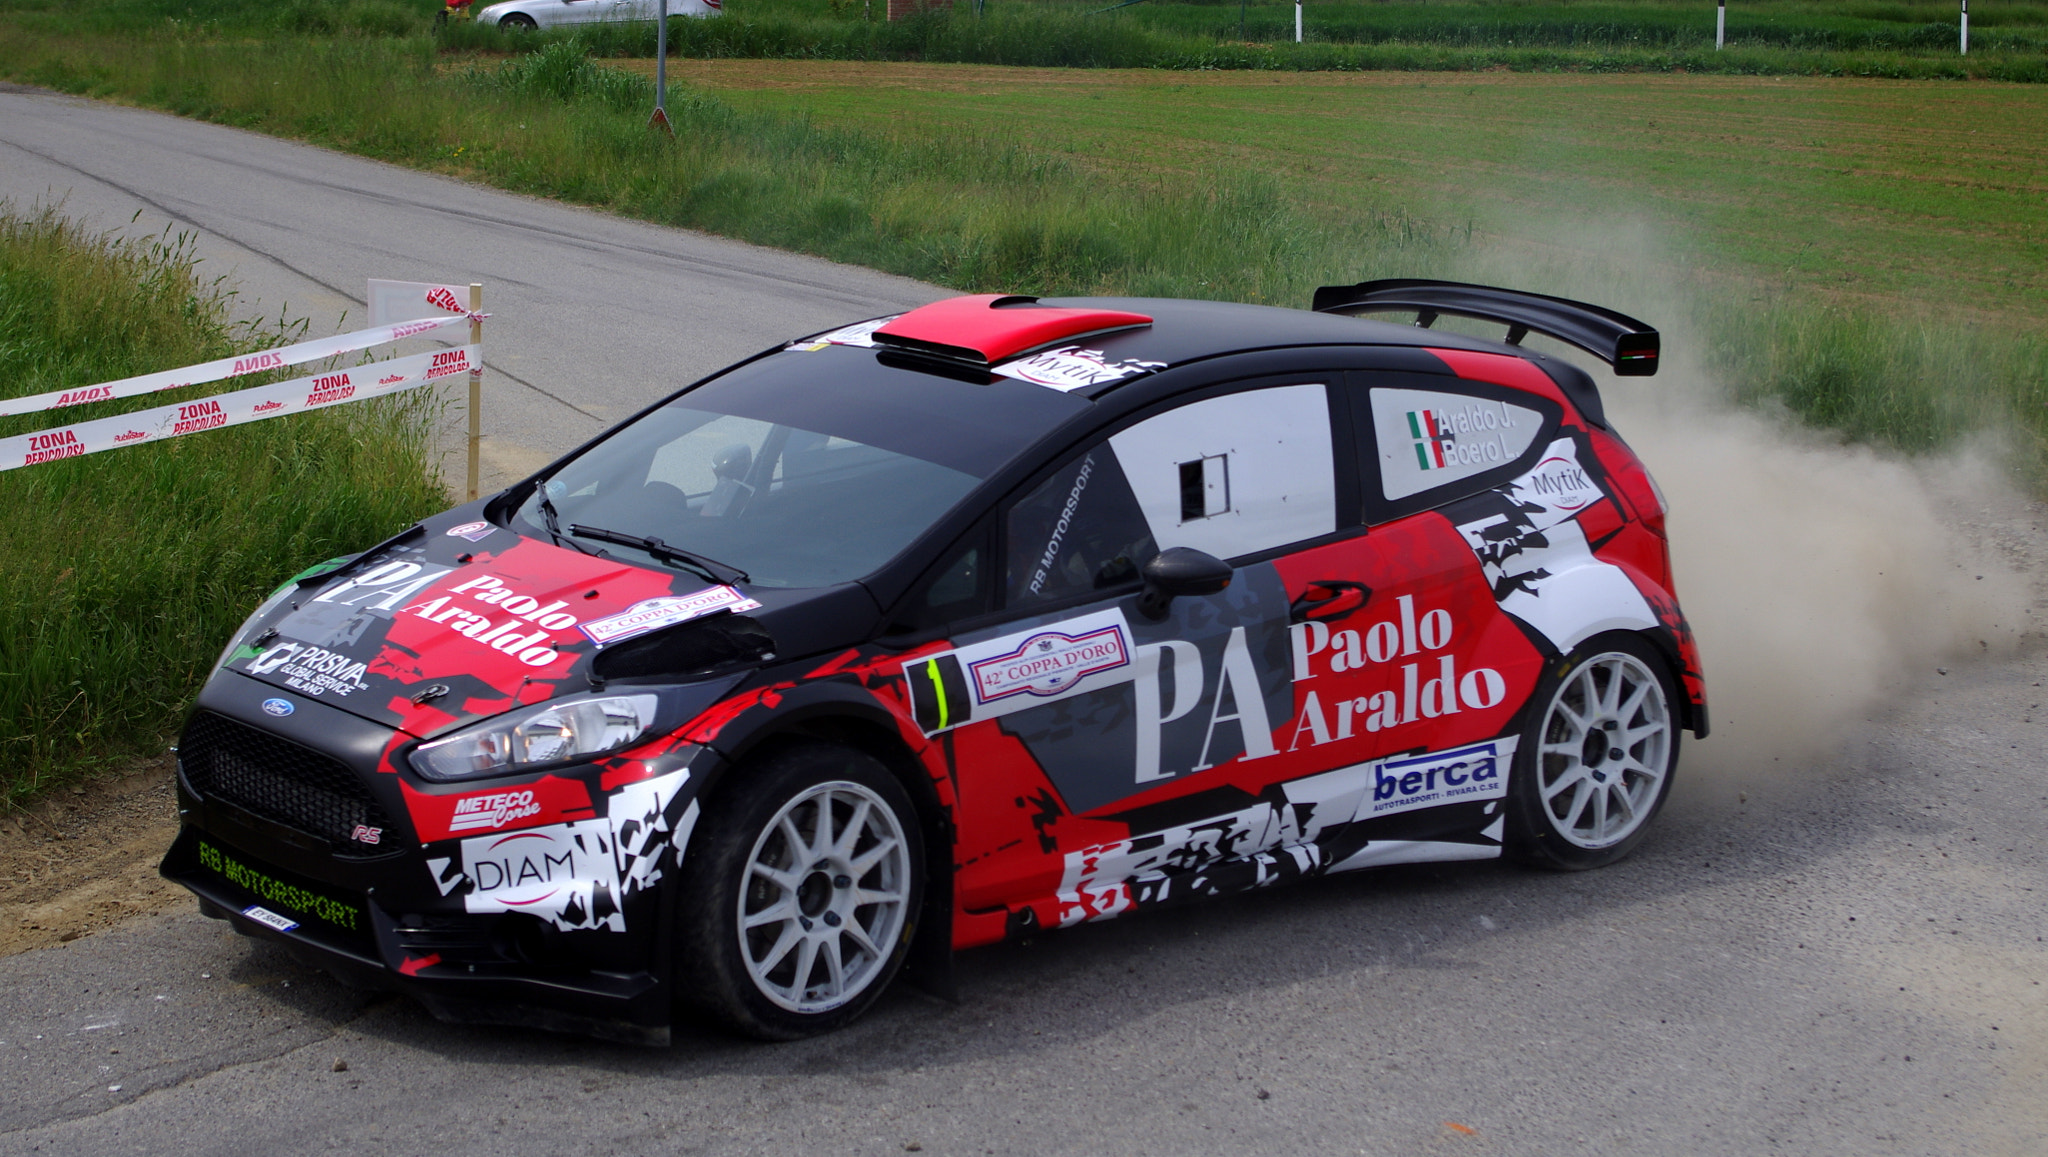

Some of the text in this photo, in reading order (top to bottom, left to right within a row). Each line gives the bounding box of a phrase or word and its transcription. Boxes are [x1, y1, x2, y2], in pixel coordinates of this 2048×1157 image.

[423, 361, 470, 380] PERICOLOSA
[432, 350, 465, 367] ZONA
[305, 386, 356, 407] PERICOLOSA
[312, 373, 350, 392] ZONA
[172, 413, 227, 436] PERICOLOSA
[178, 400, 222, 421] ZONA
[1437, 401, 1516, 438] Araldo J.
[24, 444, 85, 467] PERICOLOSA
[29, 430, 77, 451] ZONA
[1442, 434, 1521, 467] Boero L.
[1030, 570, 1047, 595] RB
[1041, 453, 1096, 570] MOTORSPORT
[312, 560, 454, 612] PA
[447, 574, 578, 631] Paolo
[618, 608, 673, 628] COPPA
[676, 592, 731, 610] D'ORO
[400, 595, 559, 667] Araldo
[1287, 593, 1454, 683] Paolo
[292, 646, 368, 687] PRISMA
[1007, 656, 1062, 680] COPPA
[1064, 641, 1117, 665] D'ORO
[280, 662, 356, 697] GLOBAL SERVICE
[284, 676, 325, 697] MILANO
[926, 658, 948, 730] 1
[264, 700, 290, 715] Ford
[1134, 626, 1280, 785] PA
[1287, 654, 1506, 753] Araldo
[1373, 757, 1498, 802] berca
[455, 790, 534, 815] METECO
[491, 802, 541, 828] Corse
[1373, 792, 1440, 812] AUTOTRASPORTI
[1446, 785, 1478, 798] RIVARA
[351, 824, 382, 845] RS
[199, 840, 359, 931] RB MOTORSPORT
[474, 849, 576, 892] DIAM
